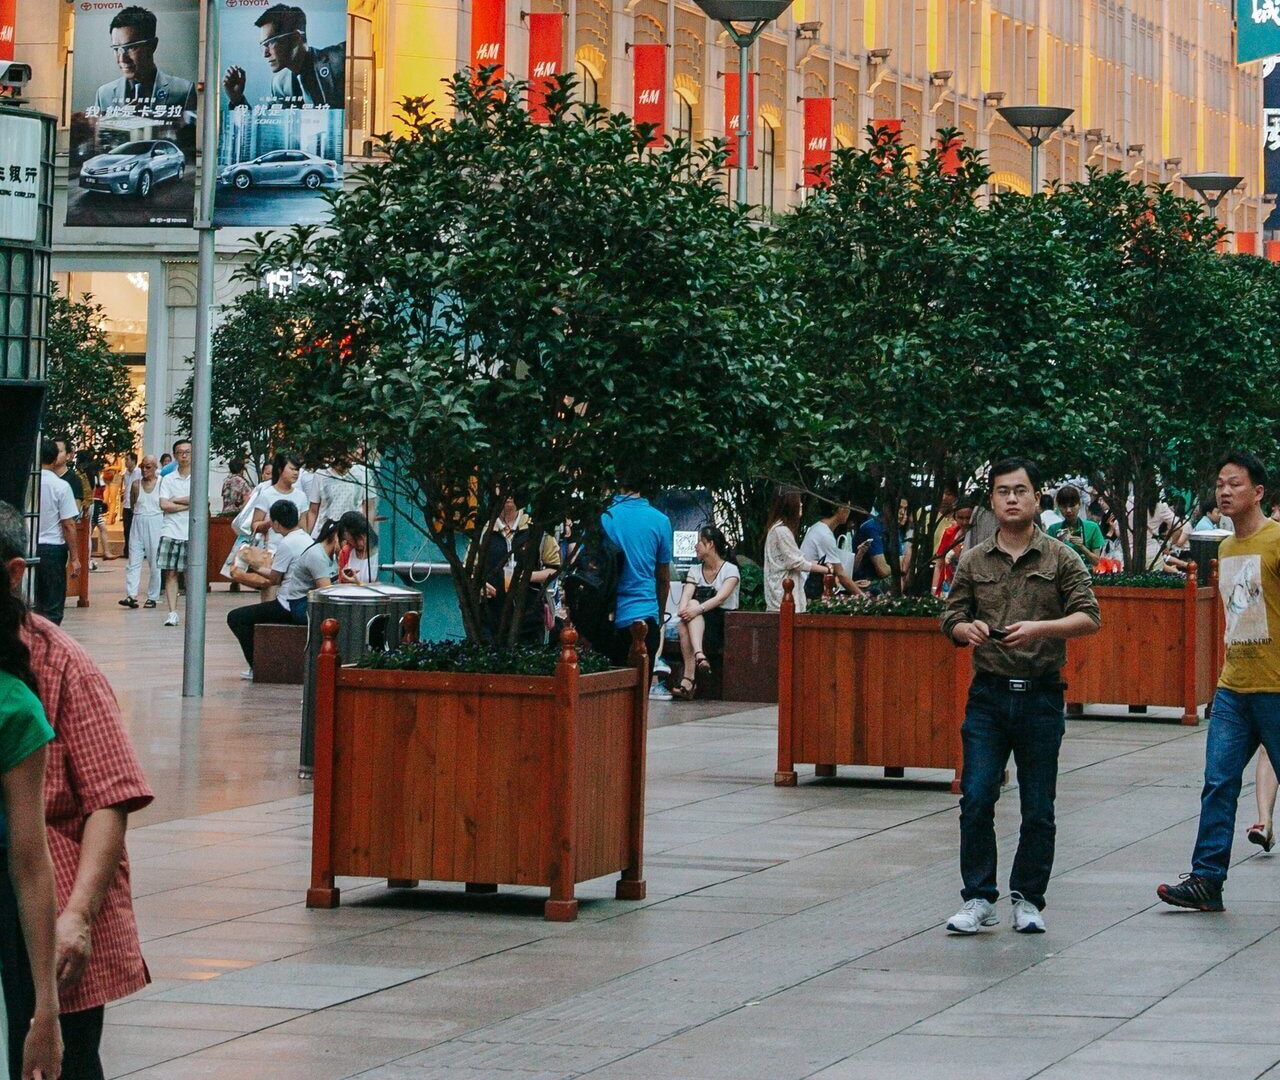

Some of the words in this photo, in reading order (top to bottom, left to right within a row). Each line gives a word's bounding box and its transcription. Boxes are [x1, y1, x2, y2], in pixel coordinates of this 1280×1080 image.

[93, 2, 123, 10] TOYOTA
[476, 43, 500, 59] H&M
[533, 61, 556, 77] H&M
[639, 89, 660, 104] H&M
[808, 137, 827, 152] H&M
